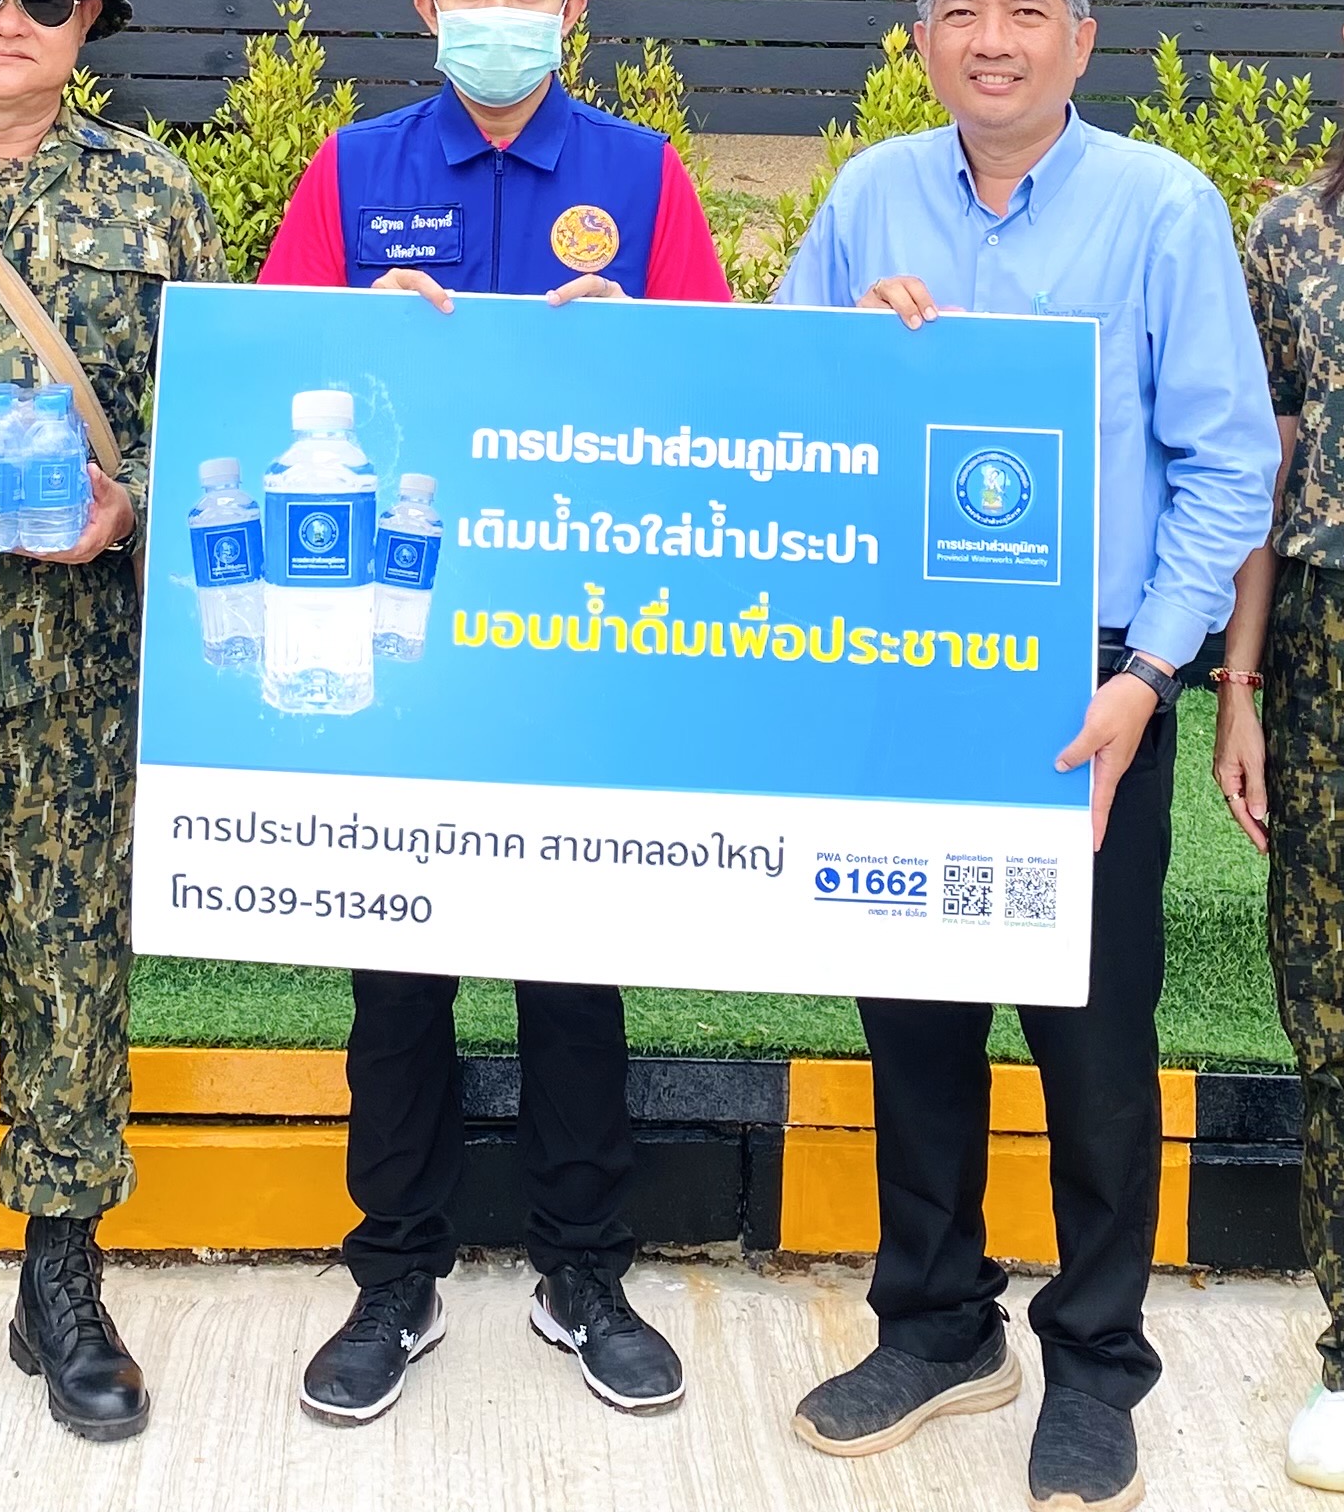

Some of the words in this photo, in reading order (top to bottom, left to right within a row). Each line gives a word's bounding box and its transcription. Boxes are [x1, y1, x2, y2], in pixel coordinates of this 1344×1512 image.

[471, 424, 880, 482] การประปาส่วนภูมิภาค
[457, 493, 879, 565] เติมน้ำใจใส่น้ำประปา
[936, 553, 969, 563] Provincial
[971, 554, 1013, 565] Waterworks
[1015, 557, 1048, 568] Authority
[452, 582, 1039, 672] มอบน้ำดื่มเพื่อประชาชน
[172, 810, 526, 864] การประปาส่วนภูมิภาค
[540, 832, 785, 878] สาขาคลองใหญ่
[816, 852, 841, 862] PWA
[846, 853, 888, 865] Contact
[892, 855, 929, 866] Center
[945, 853, 993, 864] Application
[1006, 856, 1024, 864] Line
[1027, 856, 1058, 865] Official
[171, 873, 433, 923] โทร.039-513490
[846, 868, 928, 897] 1662
